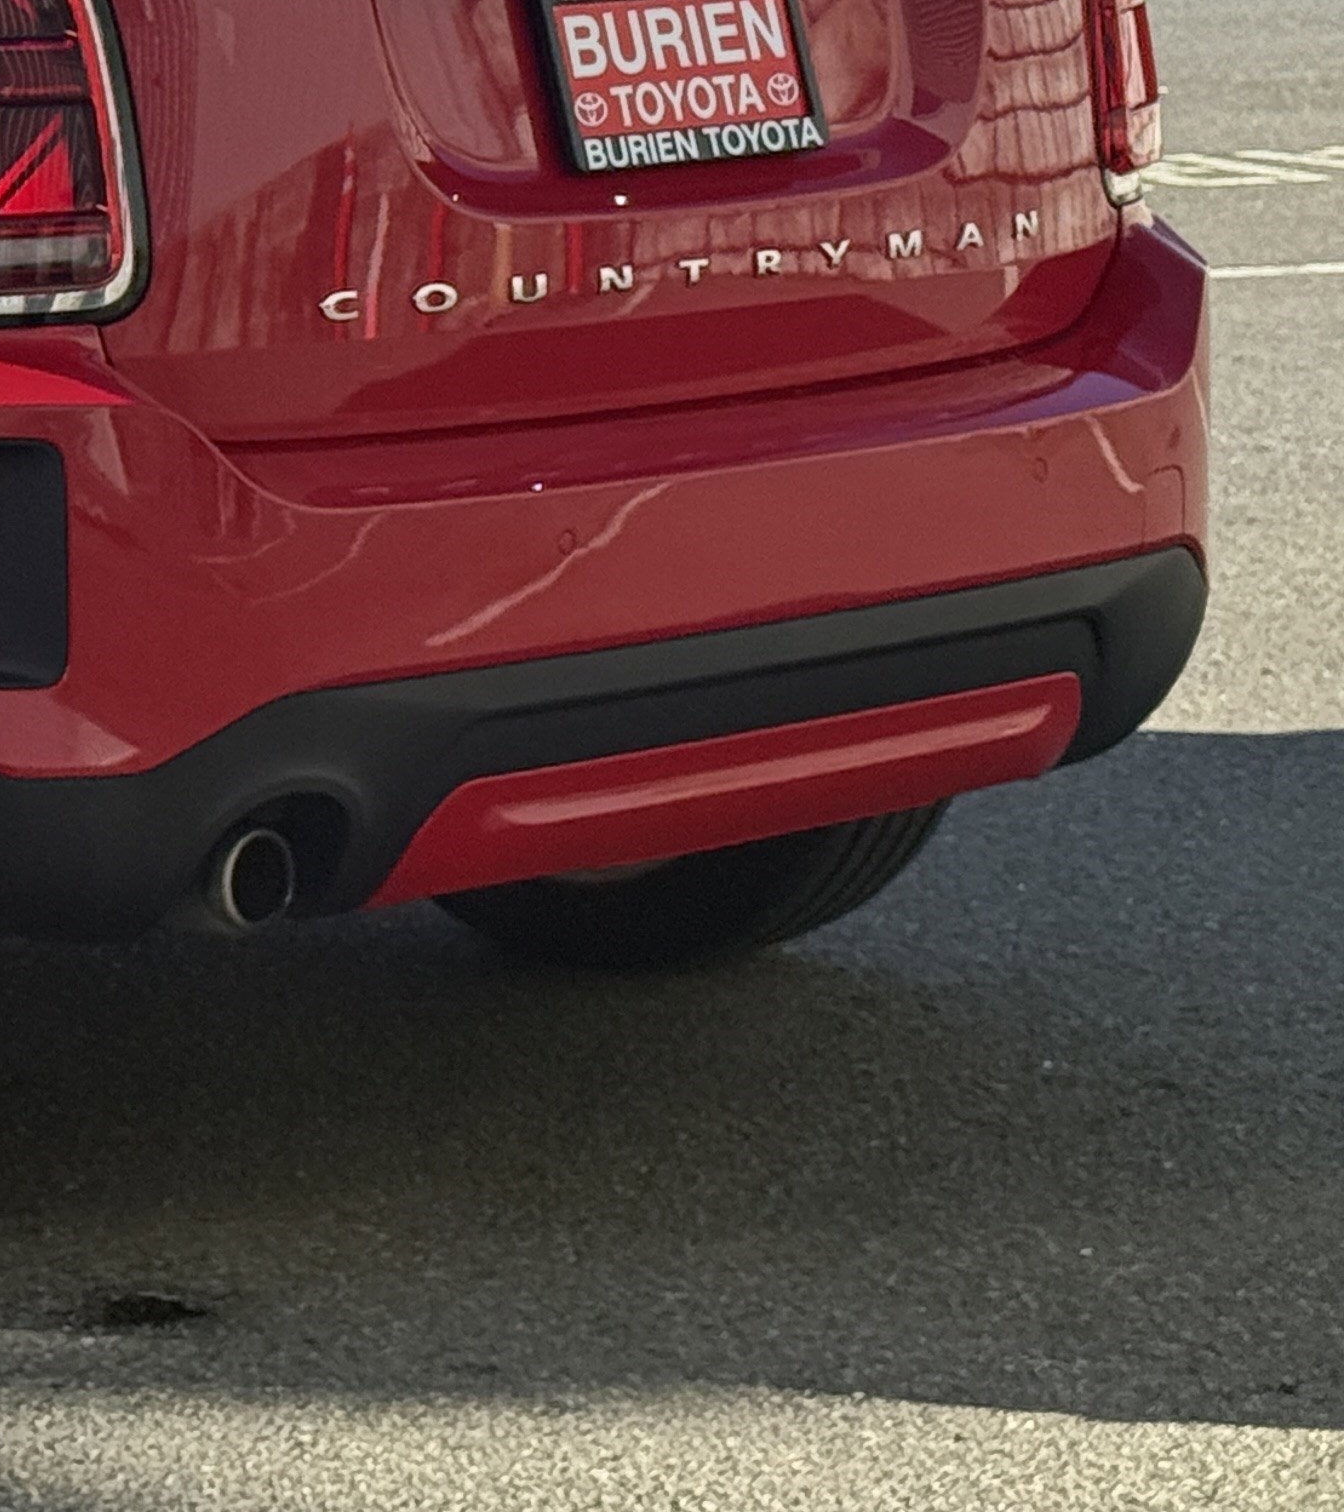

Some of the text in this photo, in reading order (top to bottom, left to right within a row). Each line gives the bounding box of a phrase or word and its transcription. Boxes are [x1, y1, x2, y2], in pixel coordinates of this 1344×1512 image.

[609, 72, 766, 127] TOYOTA
[584, 116, 825, 171] BURIEN TOYOTA
[319, 209, 1041, 323] COUNTRYMAN
